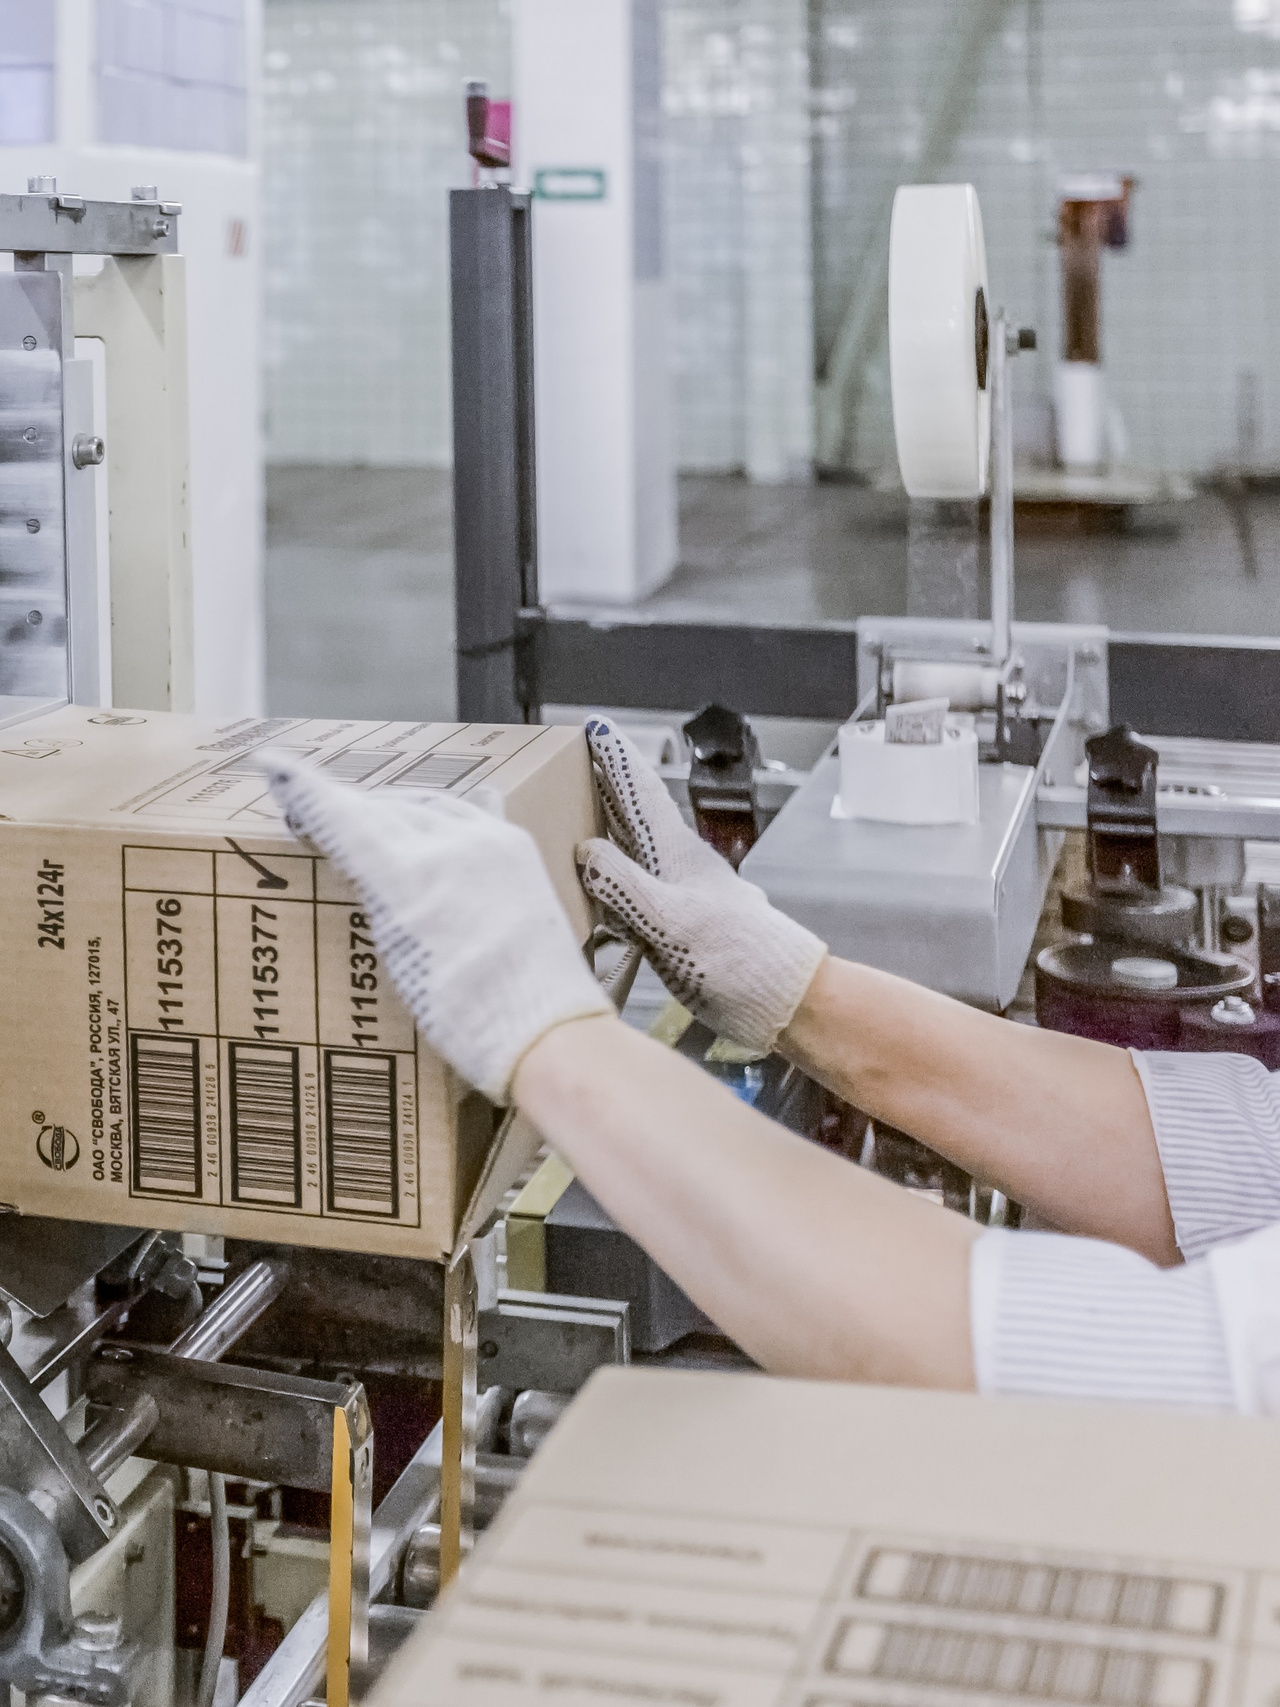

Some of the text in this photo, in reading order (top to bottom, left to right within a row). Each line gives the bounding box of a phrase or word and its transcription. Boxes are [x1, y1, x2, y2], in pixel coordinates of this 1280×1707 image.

[88, 936, 102, 986] 127015,
[89, 990, 103, 1053] РОССИЯ,
[156, 898, 184, 1031] 1115376
[251, 903, 280, 1039] 1115377
[349, 911, 378, 1047] 1115378
[107, 998, 124, 1183] МОСКВА, ВЯТСКАЯ УЛ., 47
[92, 1149, 105, 1181] ОАО
